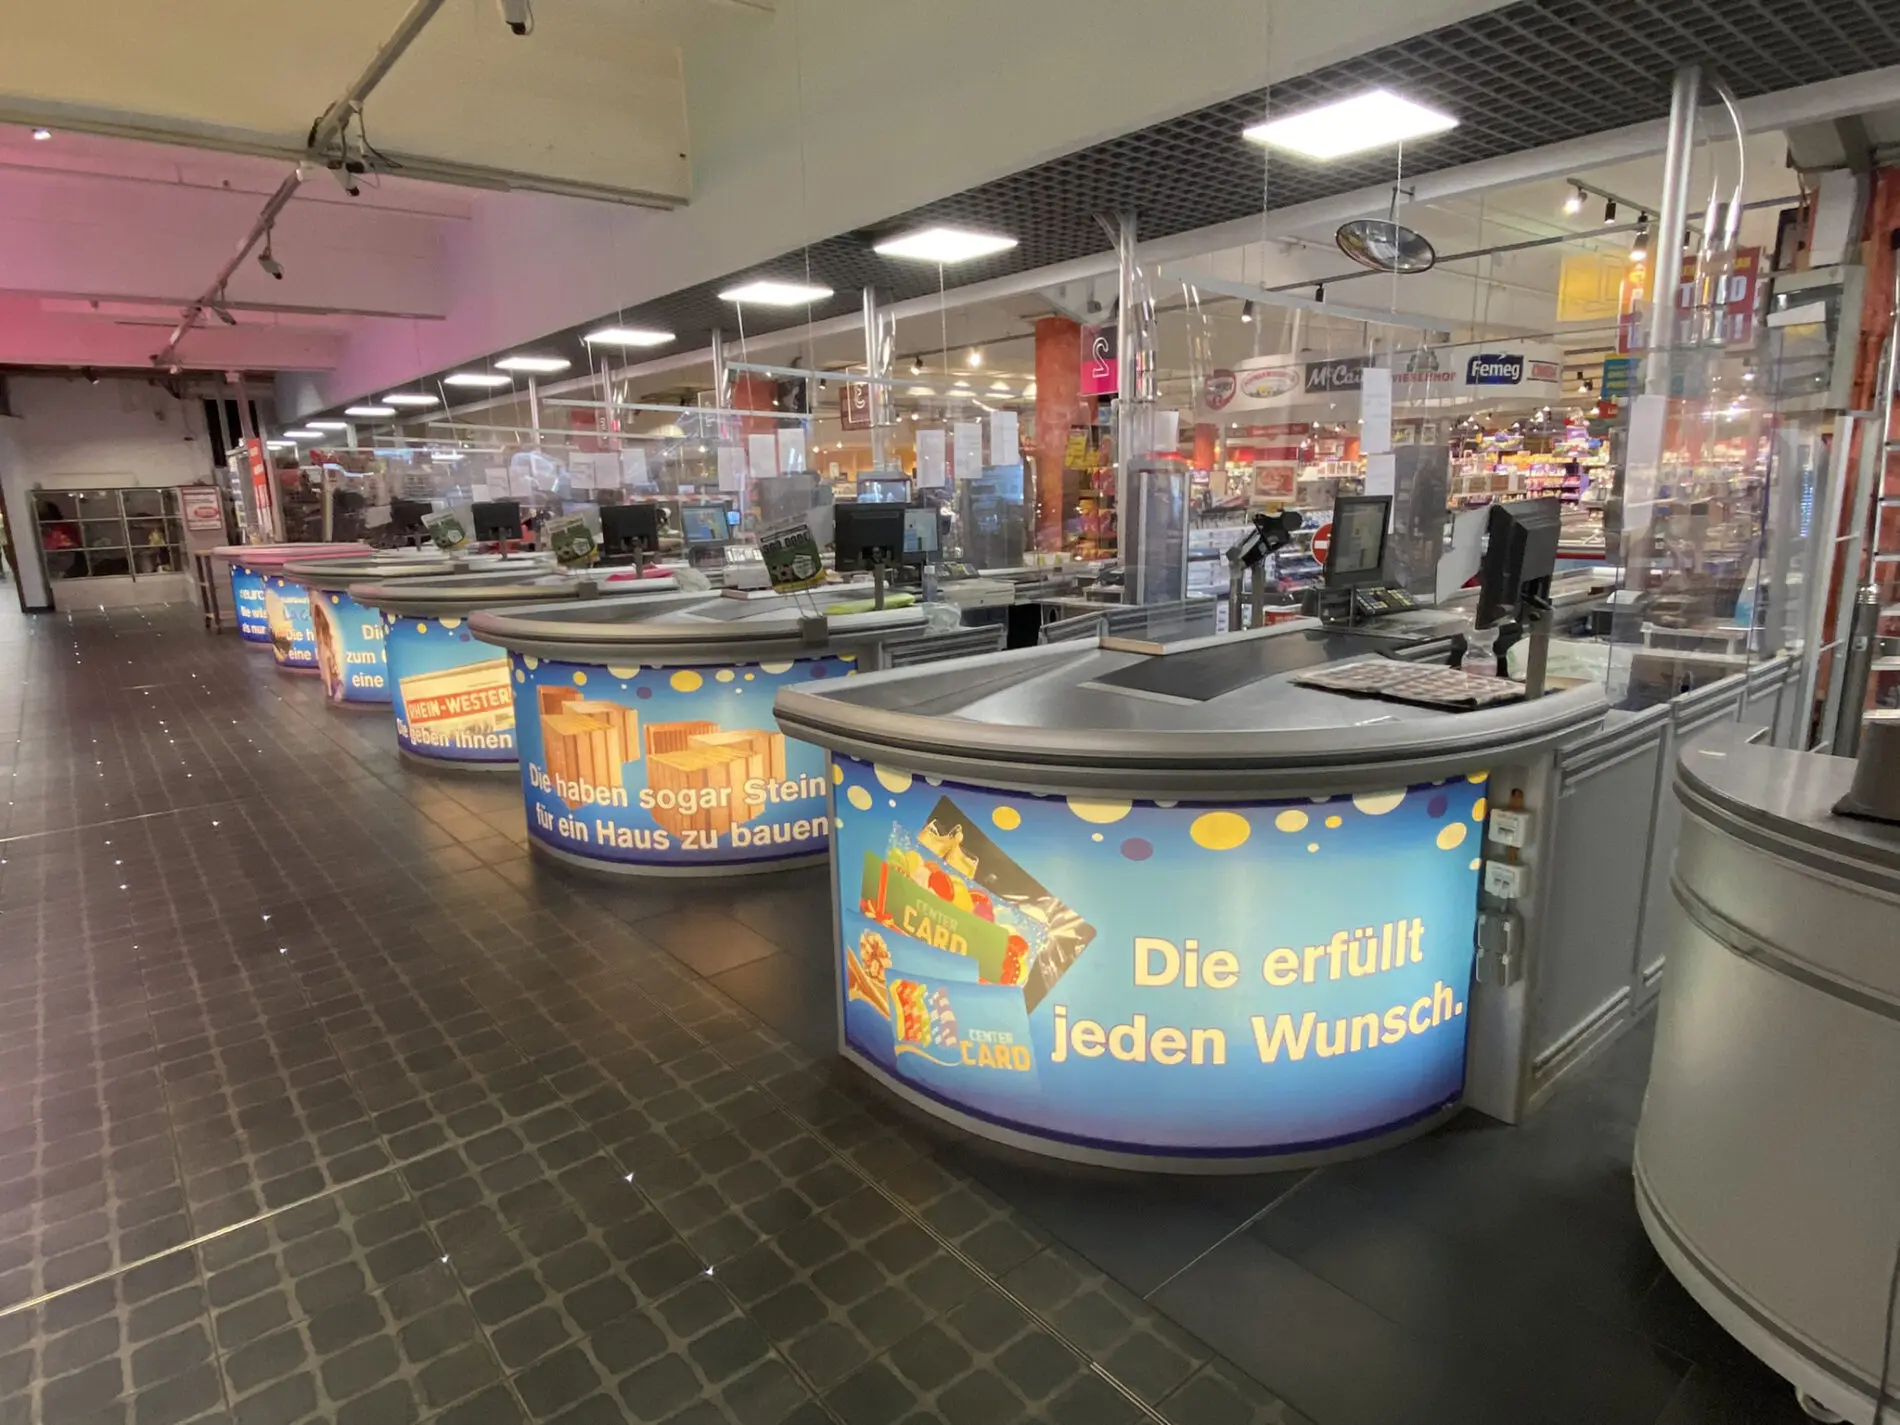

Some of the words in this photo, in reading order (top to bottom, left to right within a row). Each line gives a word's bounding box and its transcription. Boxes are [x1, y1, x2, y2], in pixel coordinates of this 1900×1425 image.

[1307, 364, 1362, 389] McCai
[1470, 359, 1521, 380] Femeg
[288, 648, 312, 661] eine
[346, 650, 376, 664] zum
[351, 672, 384, 688] eine
[407, 687, 511, 721] RHEIN-WESTER
[396, 717, 409, 739] Die
[410, 726, 450, 746] geben
[455, 730, 513, 749] Ihnen
[528, 761, 553, 794] Die
[555, 773, 628, 808] haben
[638, 786, 732, 815] sogar
[743, 773, 826, 806] Stein
[535, 801, 555, 832] für
[558, 813, 589, 842] ein
[596, 819, 670, 850] Haus
[680, 827, 719, 850] zu
[730, 815, 829, 849] bauen
[902, 904, 968, 957] CARD
[915, 898, 959, 932] CENTER
[1133, 935, 1241, 990] Die
[1261, 916, 1425, 987] erfüllt
[967, 1028, 1014, 1044] CENTER
[1051, 1003, 1227, 1066] jeden
[1249, 979, 1463, 1064] Wunsch.
[959, 1039, 1032, 1072] CARD
